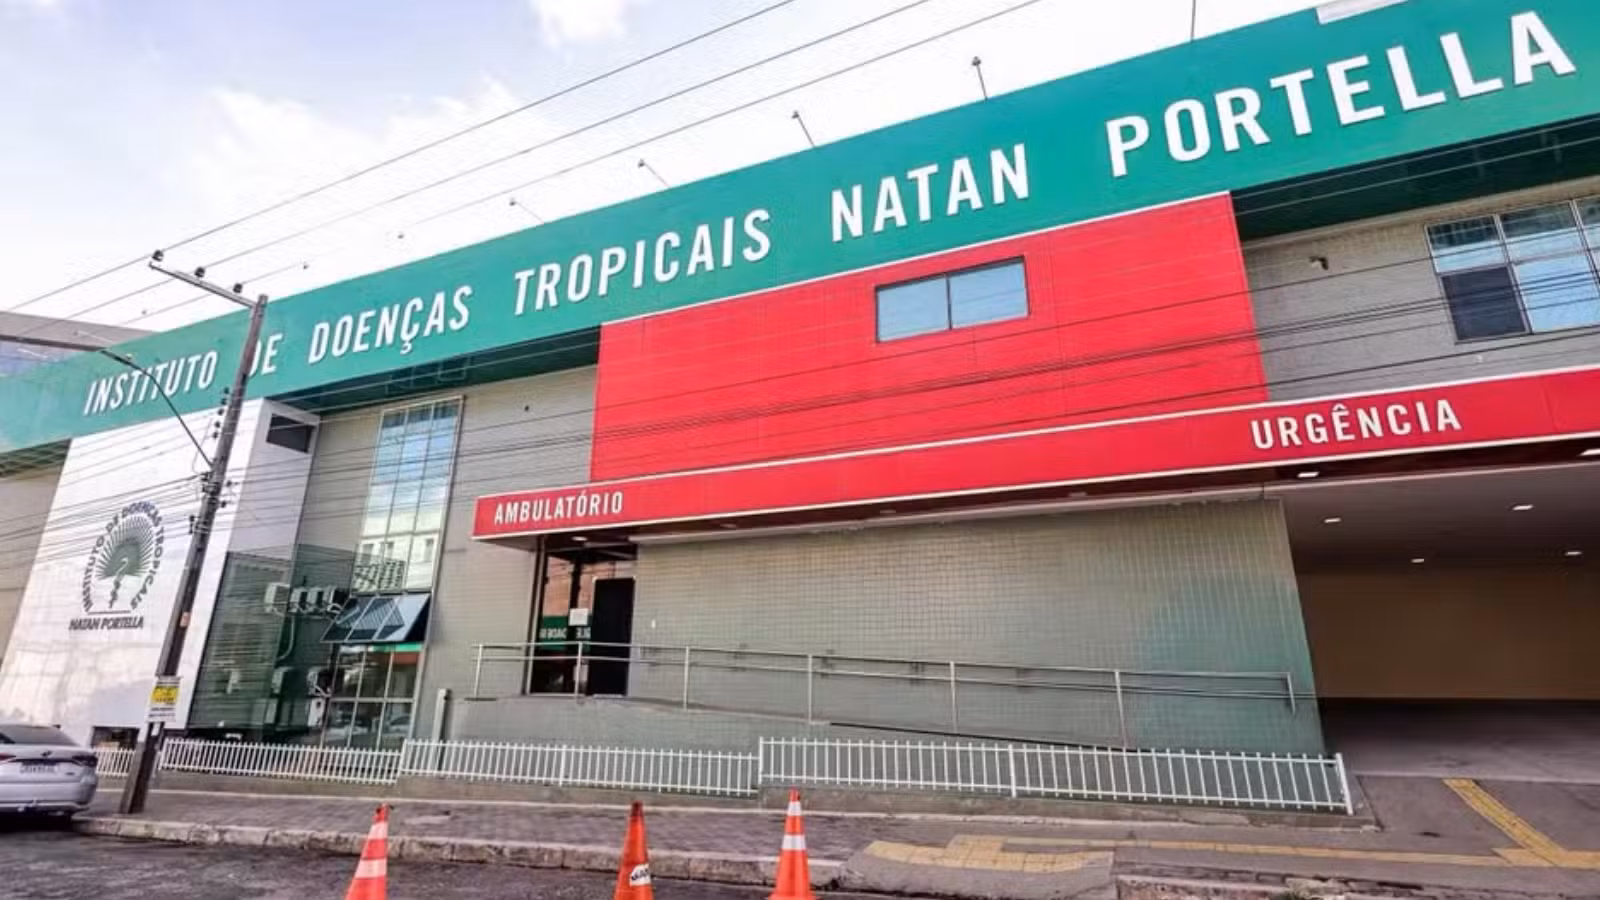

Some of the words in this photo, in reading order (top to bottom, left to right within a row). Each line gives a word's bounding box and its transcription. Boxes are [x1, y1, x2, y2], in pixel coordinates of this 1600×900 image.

[84, 351, 217, 416] INSTITUTO
[308, 285, 473, 364] DOENÇAS
[513, 208, 772, 316] TROPICAIS
[830, 143, 1030, 242] NATAN
[1105, 10, 1577, 178] PORTELLA
[1251, 399, 1462, 449] URGÊNCIA
[493, 489, 624, 525] AMBULATÓRIO
[68, 617, 101, 631] NATAN
[101, 616, 144, 630] PORTELLA
